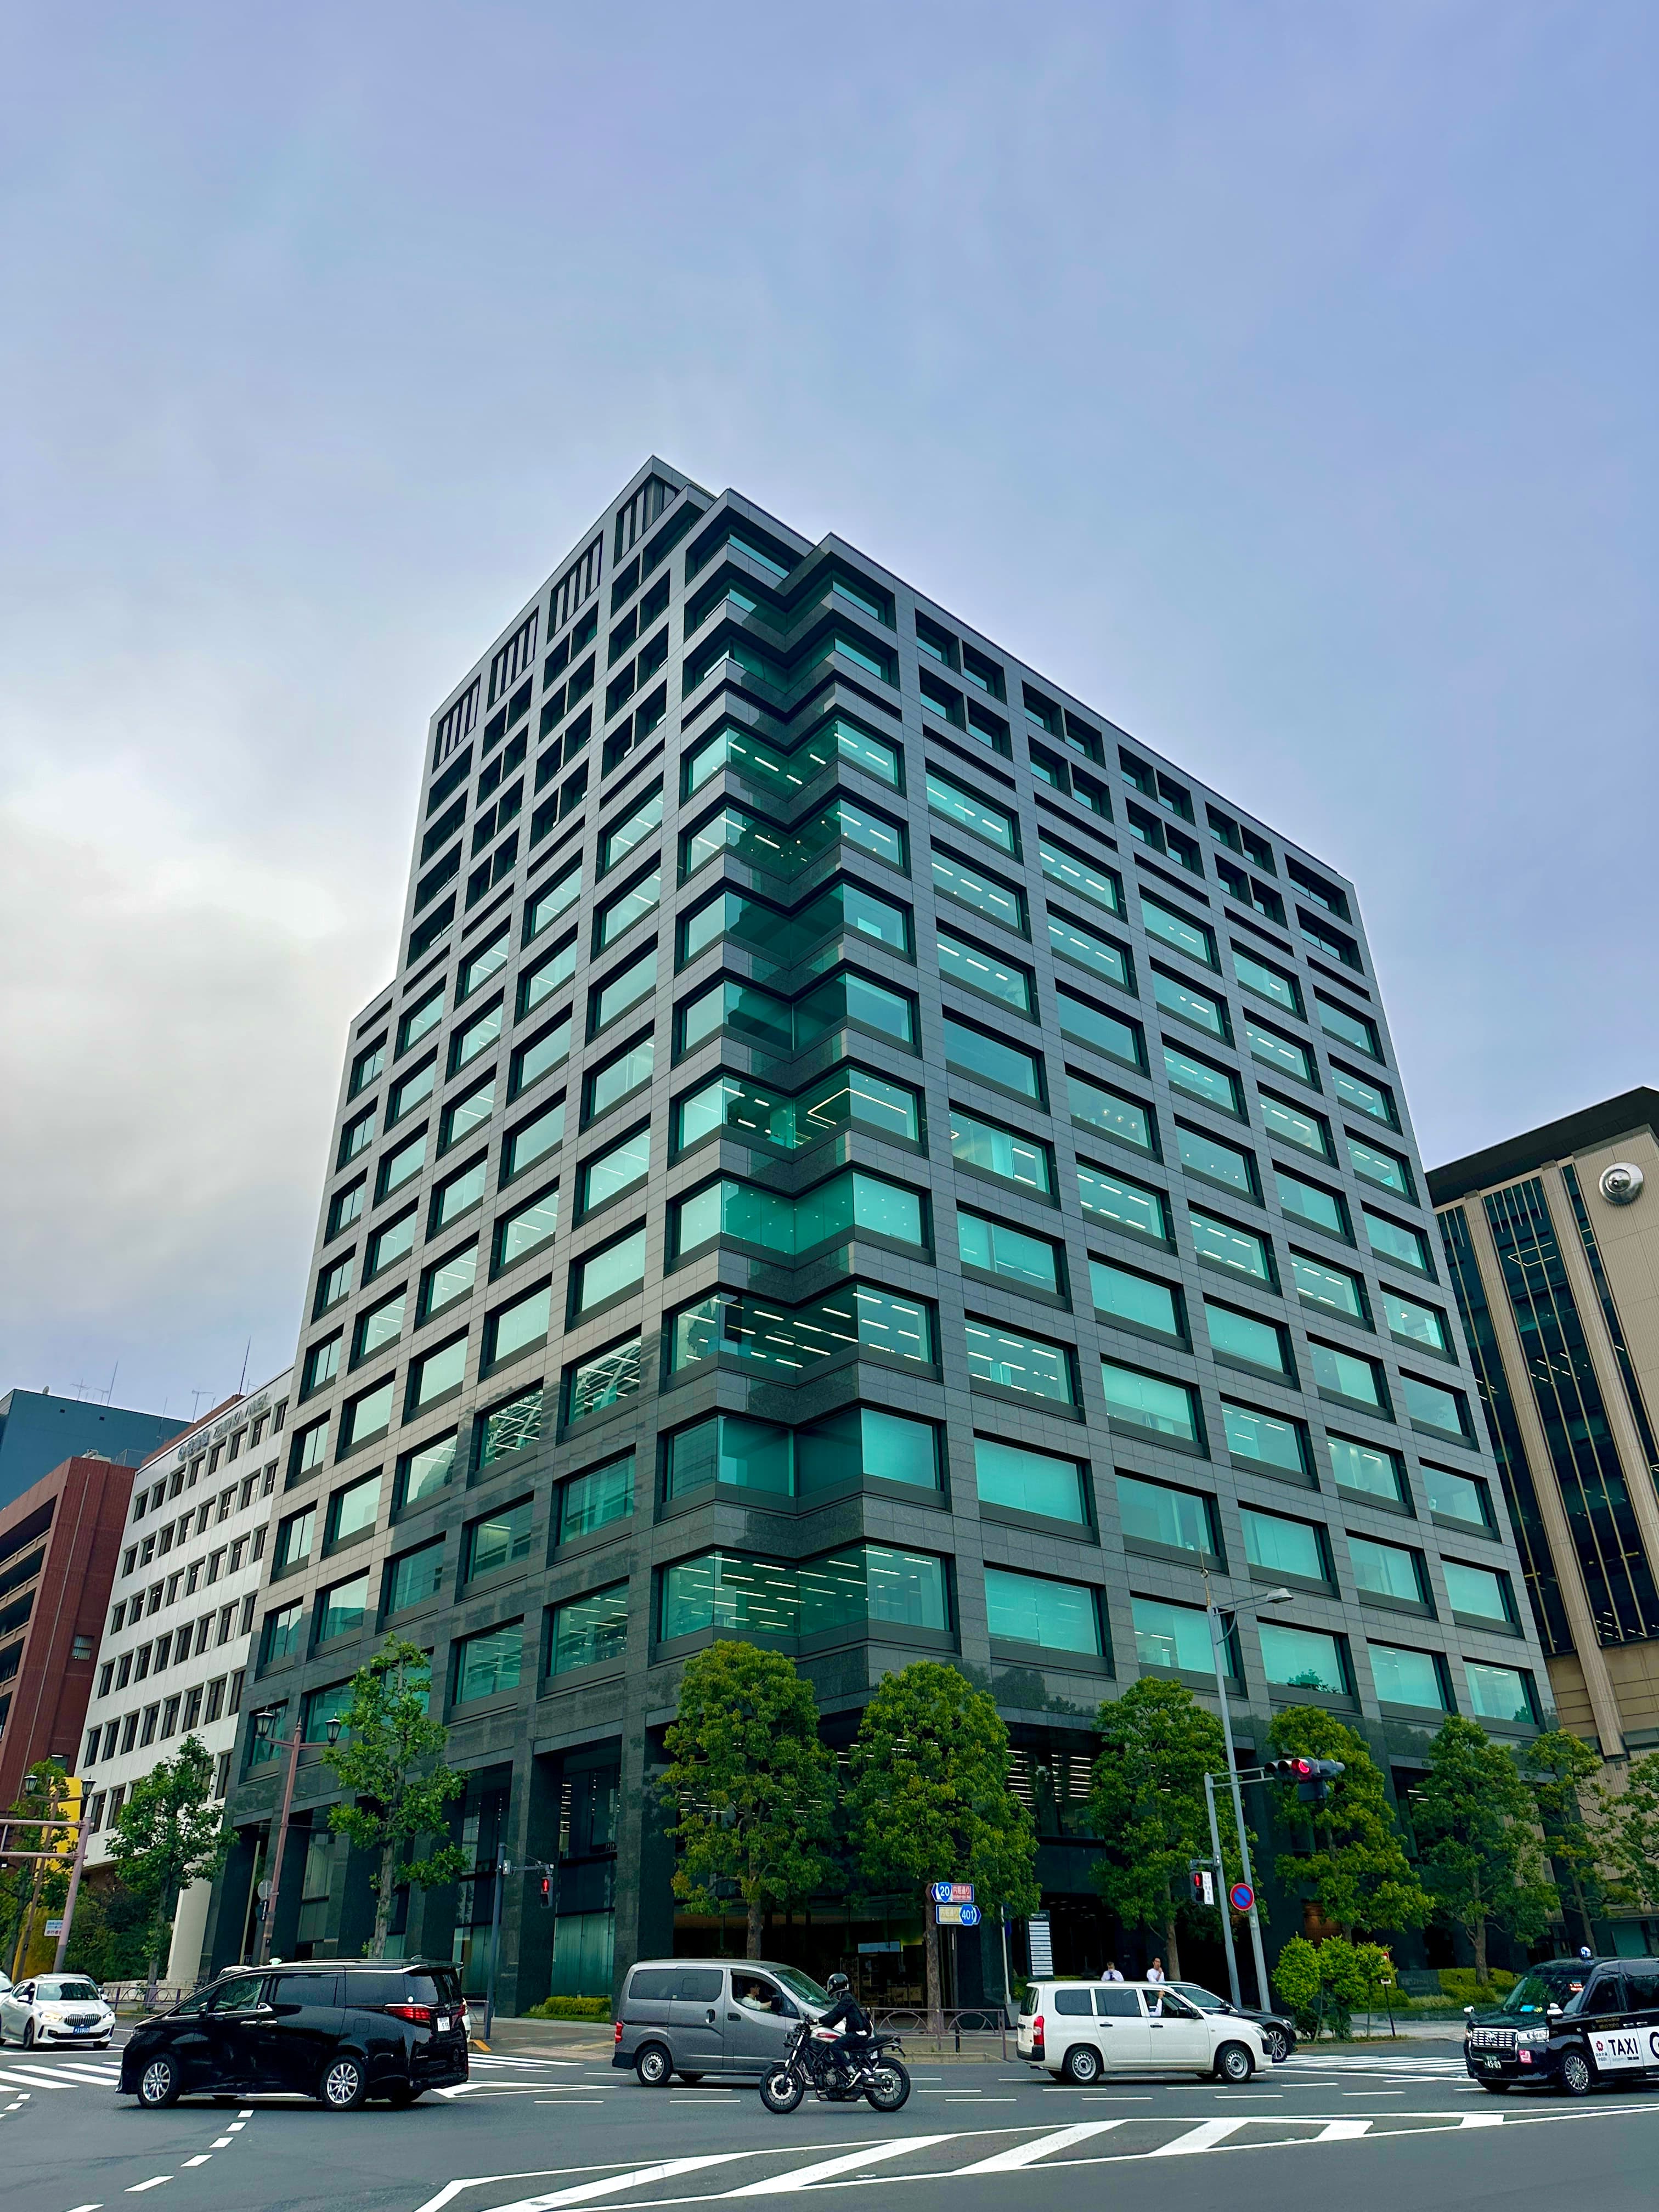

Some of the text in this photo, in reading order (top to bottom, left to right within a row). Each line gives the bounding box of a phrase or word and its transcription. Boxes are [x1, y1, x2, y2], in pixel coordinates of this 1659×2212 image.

[940, 1886, 950, 1896] 20
[962, 1909, 974, 1920] 401
[1608, 2038, 1638, 2056] TAXI
